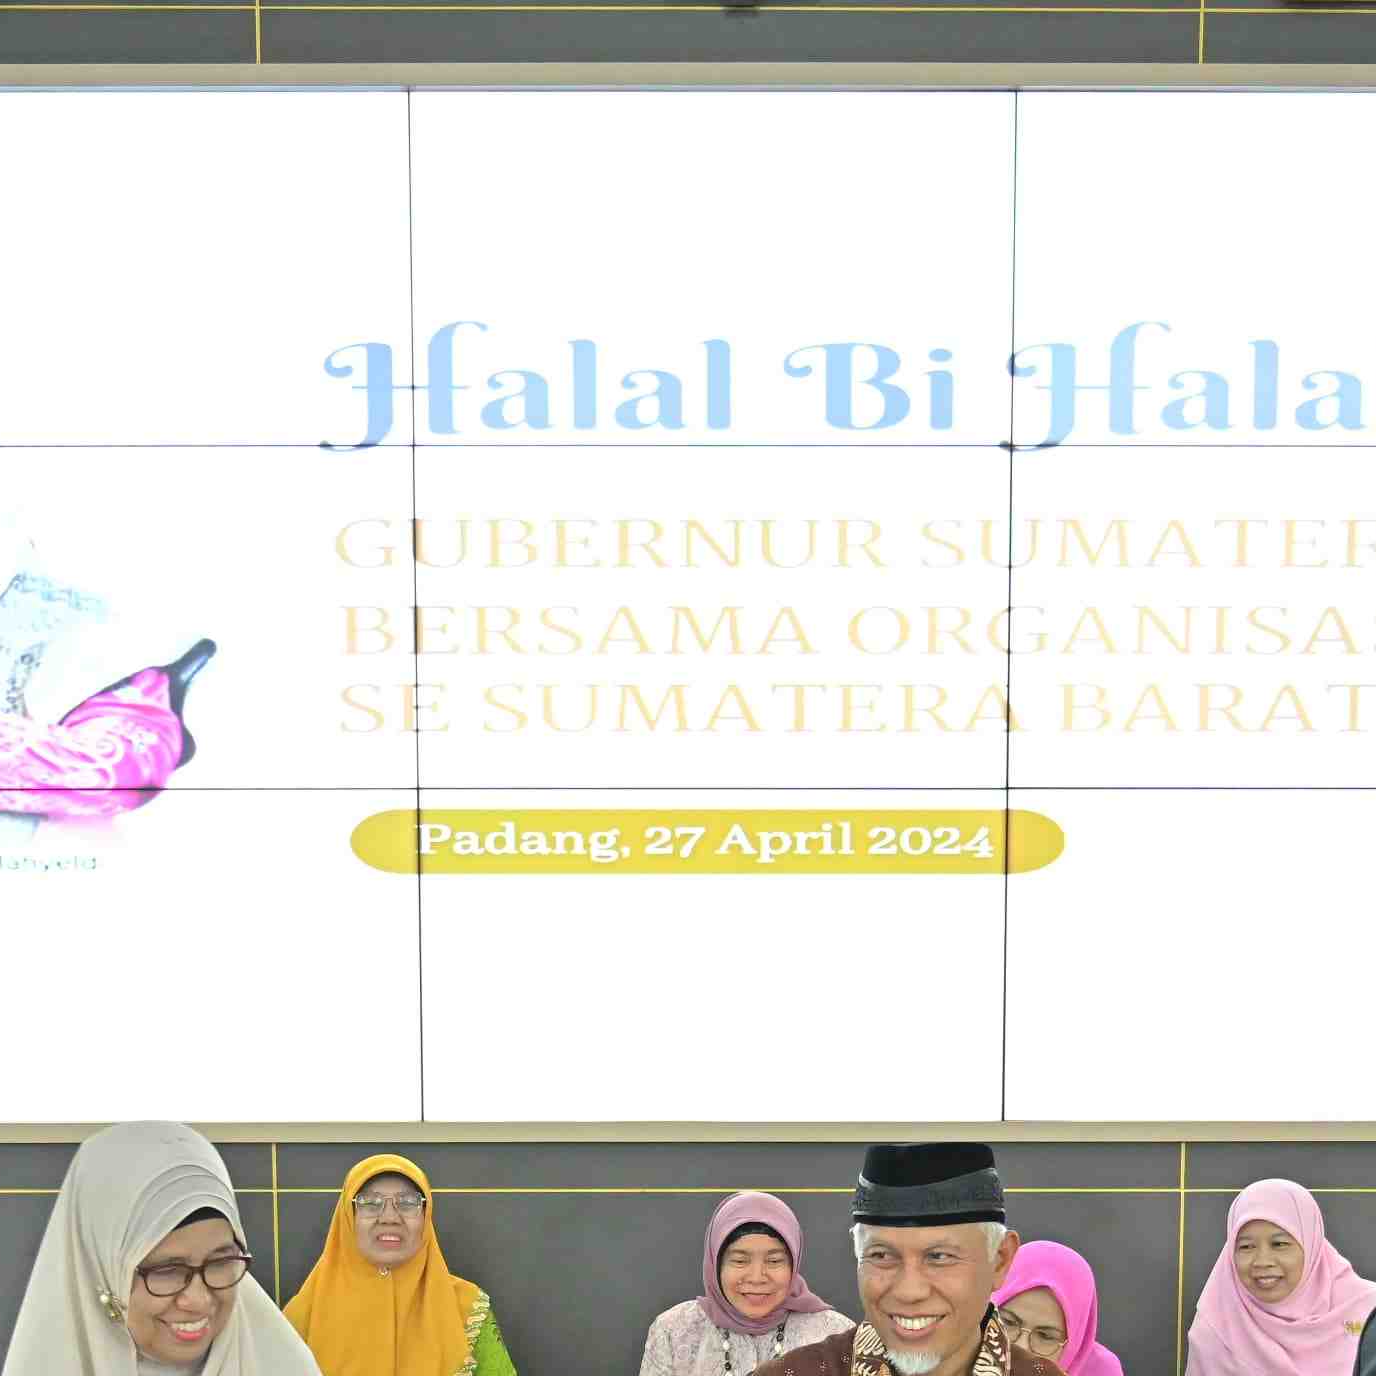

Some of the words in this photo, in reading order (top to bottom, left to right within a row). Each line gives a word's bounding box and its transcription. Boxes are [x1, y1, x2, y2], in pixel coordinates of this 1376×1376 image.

[319, 320, 734, 453] Halal
[783, 340, 959, 433] Bi
[333, 515, 885, 570] GUBERNUR
[340, 604, 820, 659] BERSAMA
[337, 682, 451, 735] SE
[480, 681, 1024, 735] SUMATERA
[415, 821, 631, 862] Padang,
[644, 826, 706, 857] 27
[718, 821, 855, 863] April
[867, 826, 994, 858] 2024
